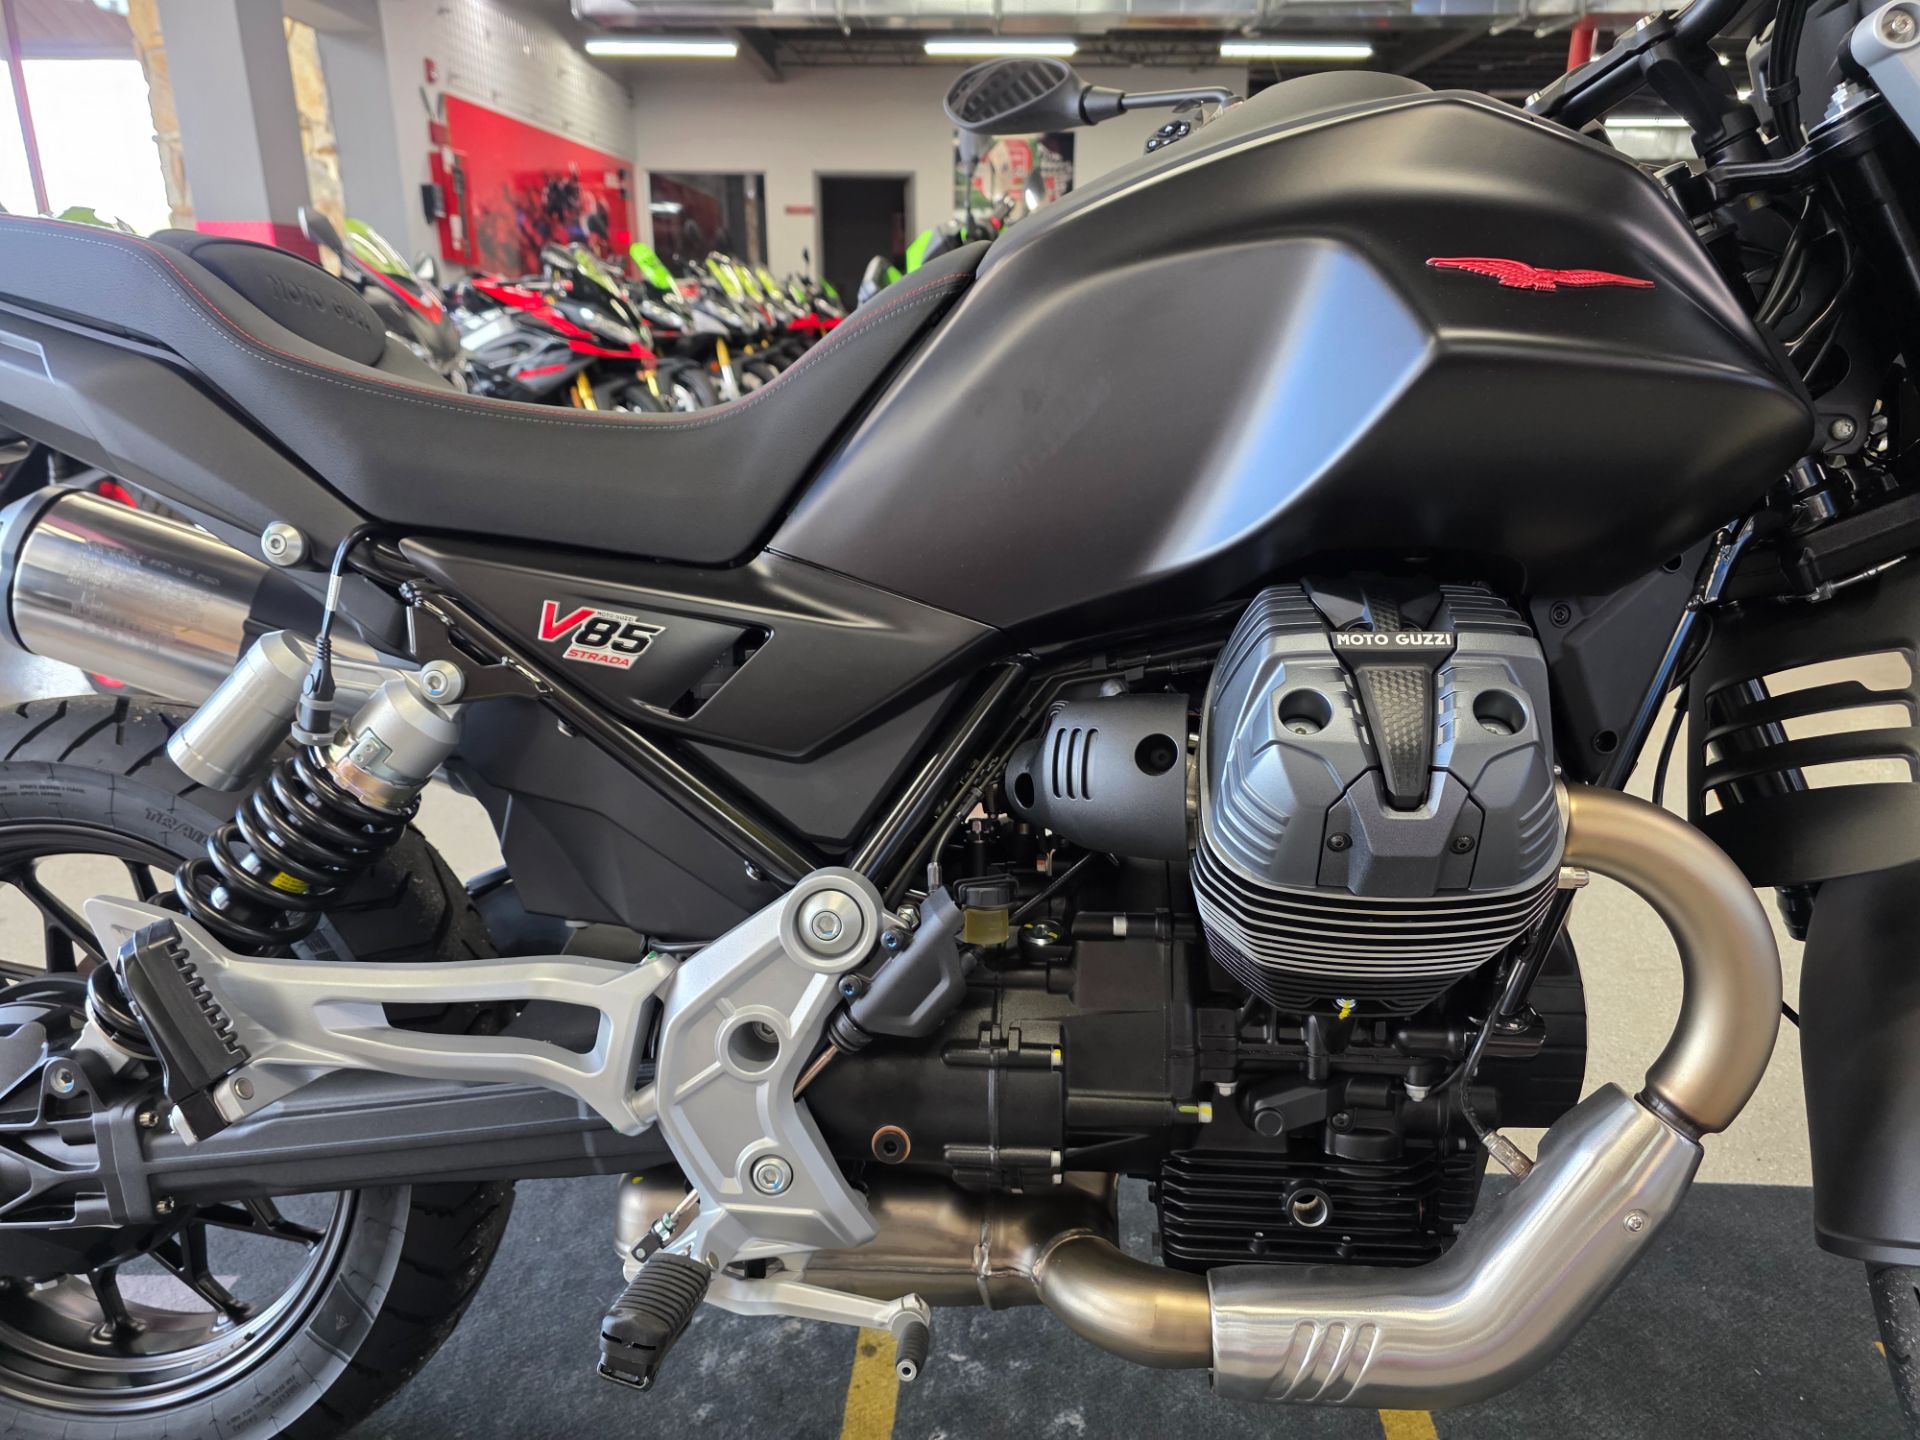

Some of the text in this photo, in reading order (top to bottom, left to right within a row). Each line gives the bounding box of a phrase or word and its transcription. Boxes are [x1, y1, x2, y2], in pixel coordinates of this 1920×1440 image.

[538, 600, 664, 655] V85
[1336, 633, 1451, 646] MOTO GUZZI
[567, 649, 630, 667] STRADA
